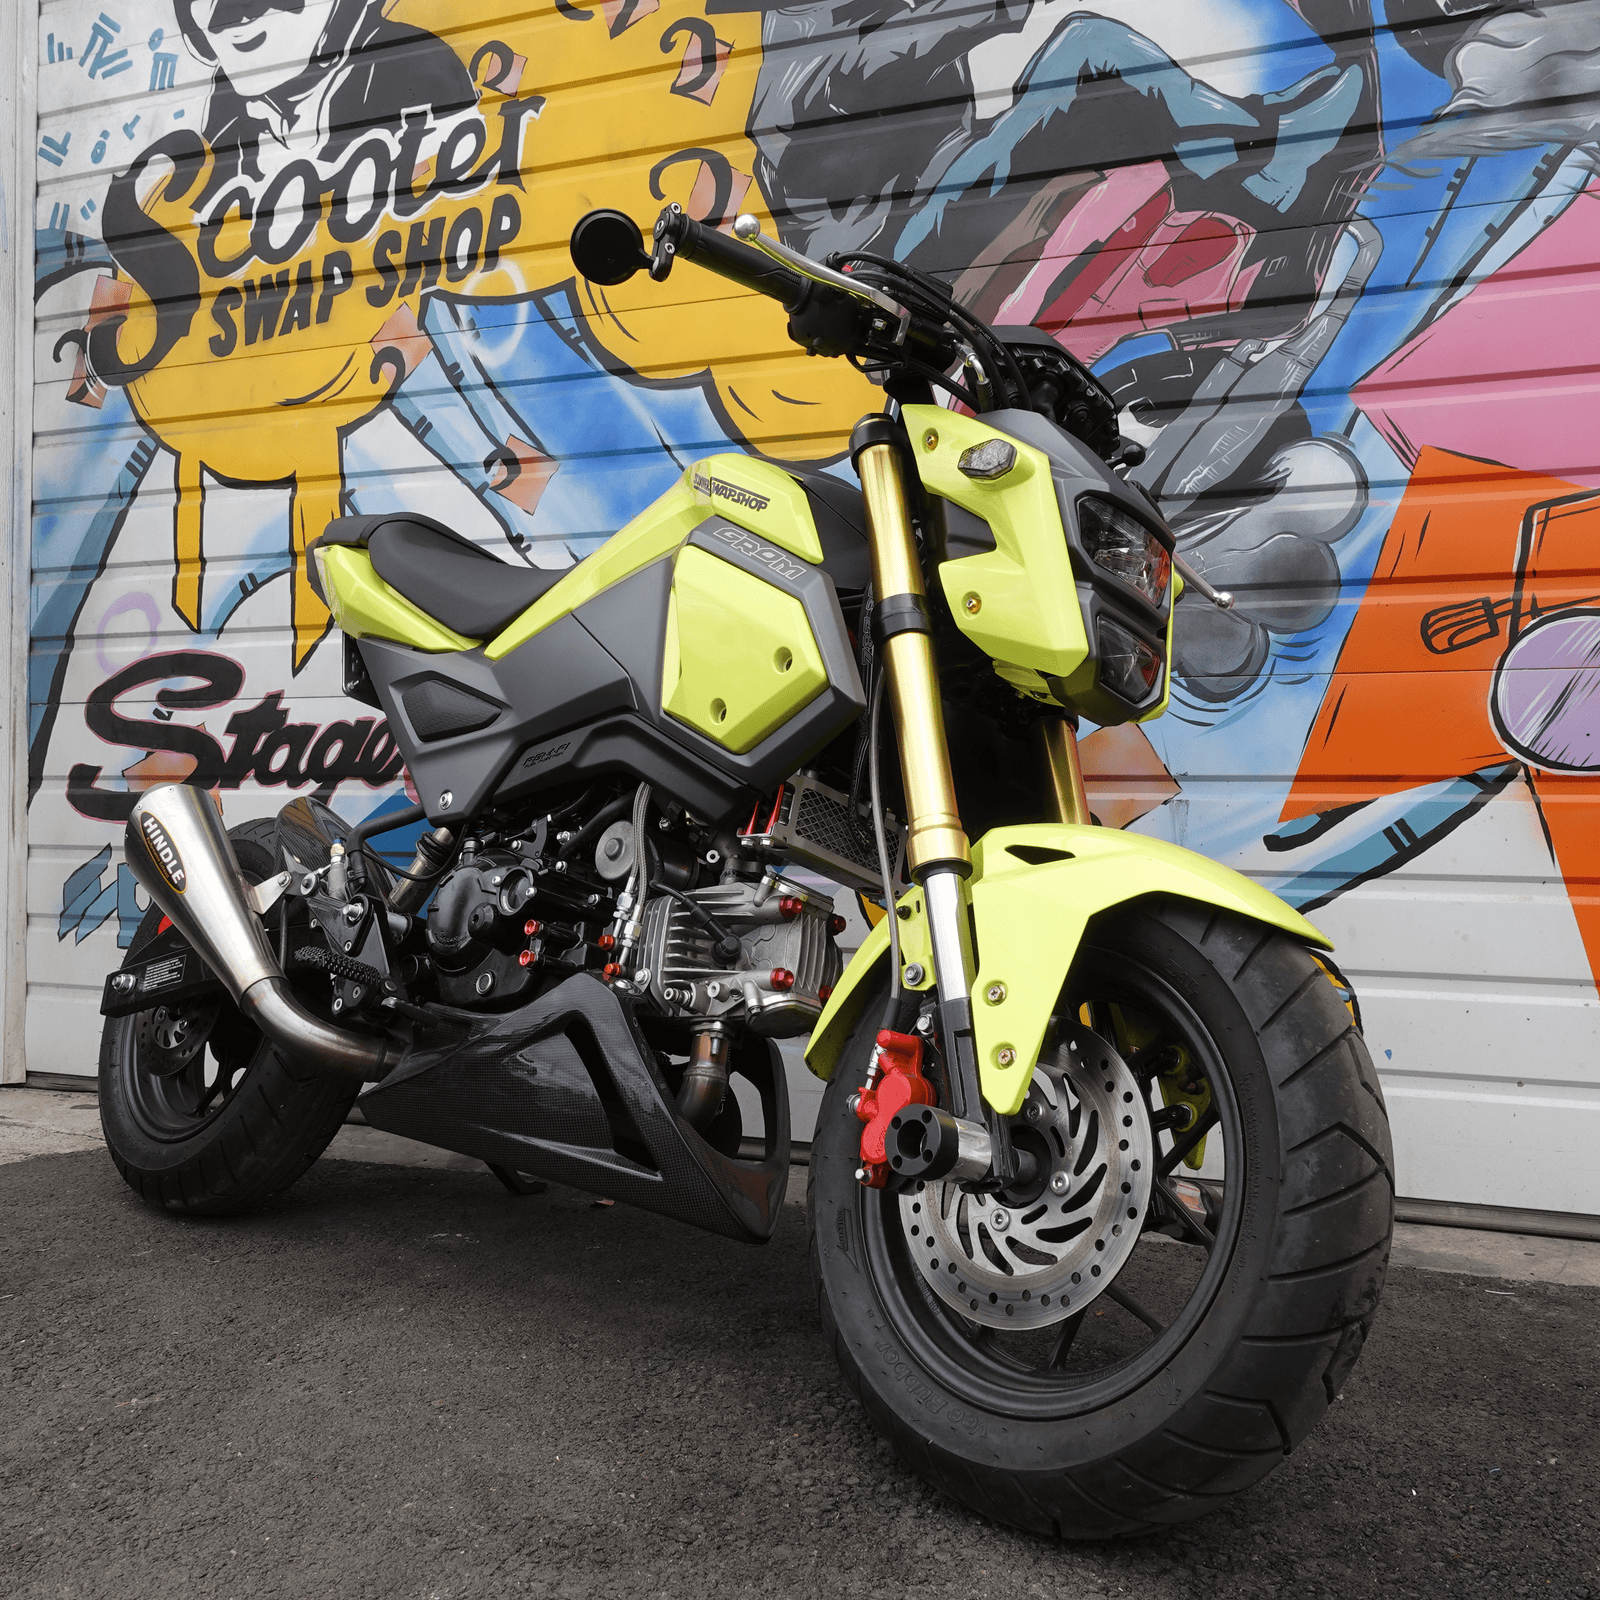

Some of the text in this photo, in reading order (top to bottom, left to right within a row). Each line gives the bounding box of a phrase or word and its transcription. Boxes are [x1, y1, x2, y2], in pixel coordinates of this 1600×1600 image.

[88, 96, 546, 387] Scooter
[209, 195, 521, 357] SWAP SHOP
[713, 527, 807, 580] GROM
[143, 817, 185, 884] HINDLE
[874, 1342, 949, 1414] Rubber
